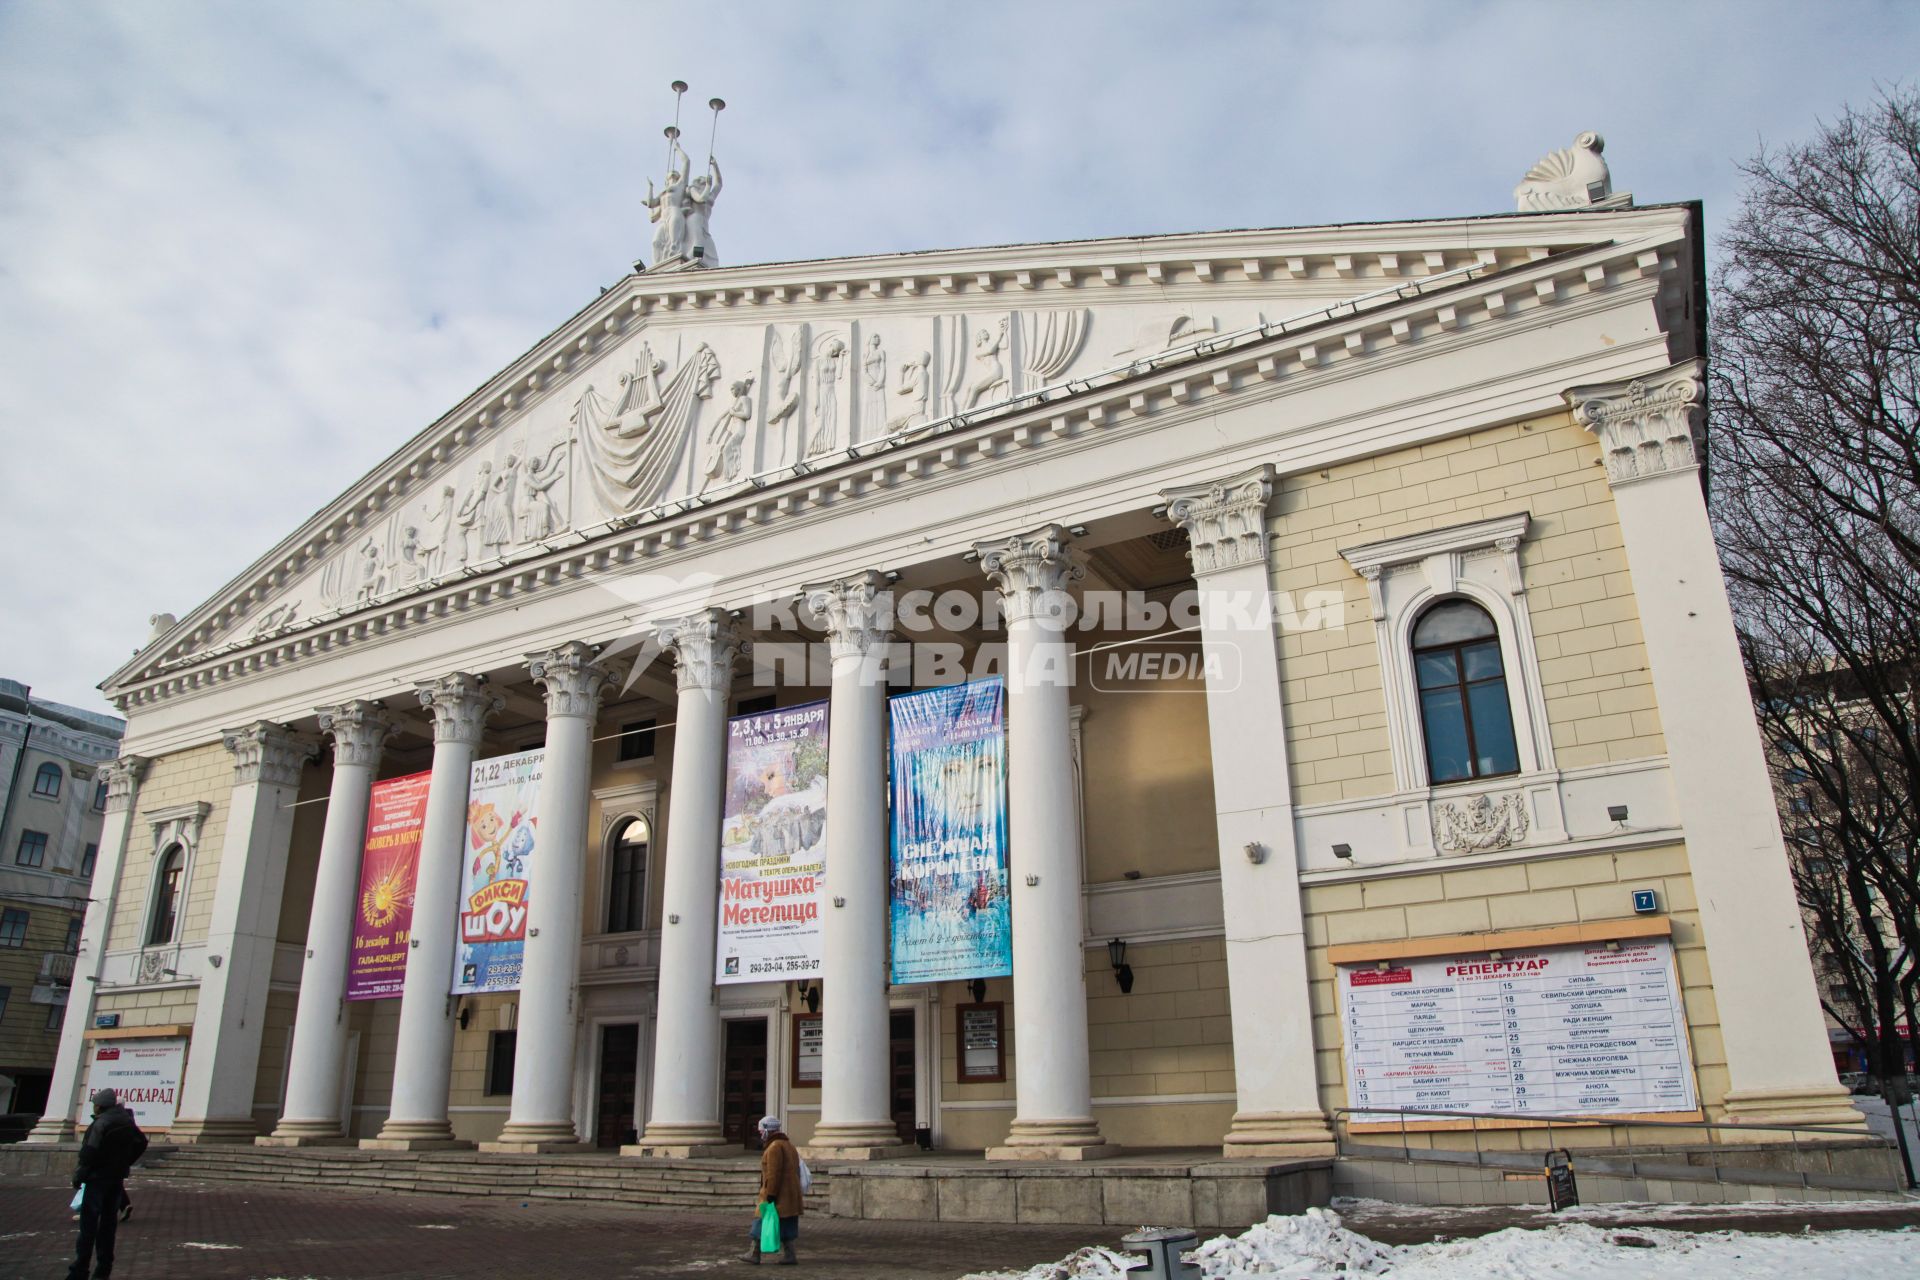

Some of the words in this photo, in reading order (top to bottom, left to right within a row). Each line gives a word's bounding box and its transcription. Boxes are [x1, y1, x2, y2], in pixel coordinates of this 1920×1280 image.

[773, 713, 781, 730] 5
[784, 709, 824, 727] ЯНВАРЯ
[474, 763, 501, 785] 21,22
[503, 754, 545, 771] ДЕКАБРЯ
[528, 772, 543, 782] 14.0
[475, 882, 521, 907] ФИКСИ
[724, 876, 822, 903] Матушка-
[1641, 897, 1647, 905] 7
[464, 901, 526, 937] ШОУ
[723, 902, 818, 926] Метелица
[488, 964, 523, 975] 293-23-0
[1446, 959, 1549, 977] РЕПЕРТУАР
[1568, 976, 1595, 984] СИЛЬВА
[1391, 989, 1420, 997] СНЕЖНАЯ
[1422, 987, 1454, 995] КОРОЛЕВА
[1541, 990, 1584, 999] СЕВИЛЬСКИЙ
[1586, 988, 1627, 996] ЦИРЮЛЬНИК
[1411, 1001, 1437, 1009] МАРИЦА
[1582, 1015, 1612, 1023] ЖЕНЩИН
[1392, 1039, 1422, 1047] НАРЦИСС
[1567, 1042, 1589, 1050] ПЕРЕД
[1590, 1040, 1637, 1049] РОЖДЕСТВОМ
[1558, 1056, 1591, 1064] СНЕЖНАЯ
[1592, 1054, 1628, 1062] КОРОЛЕВА
[1514, 1073, 1524, 1081] 28
[1556, 1070, 1588, 1078] МУЖЧИНА
[1611, 1067, 1636, 1075] МЕЧТЫ
[1516, 1086, 1526, 1094] 29
